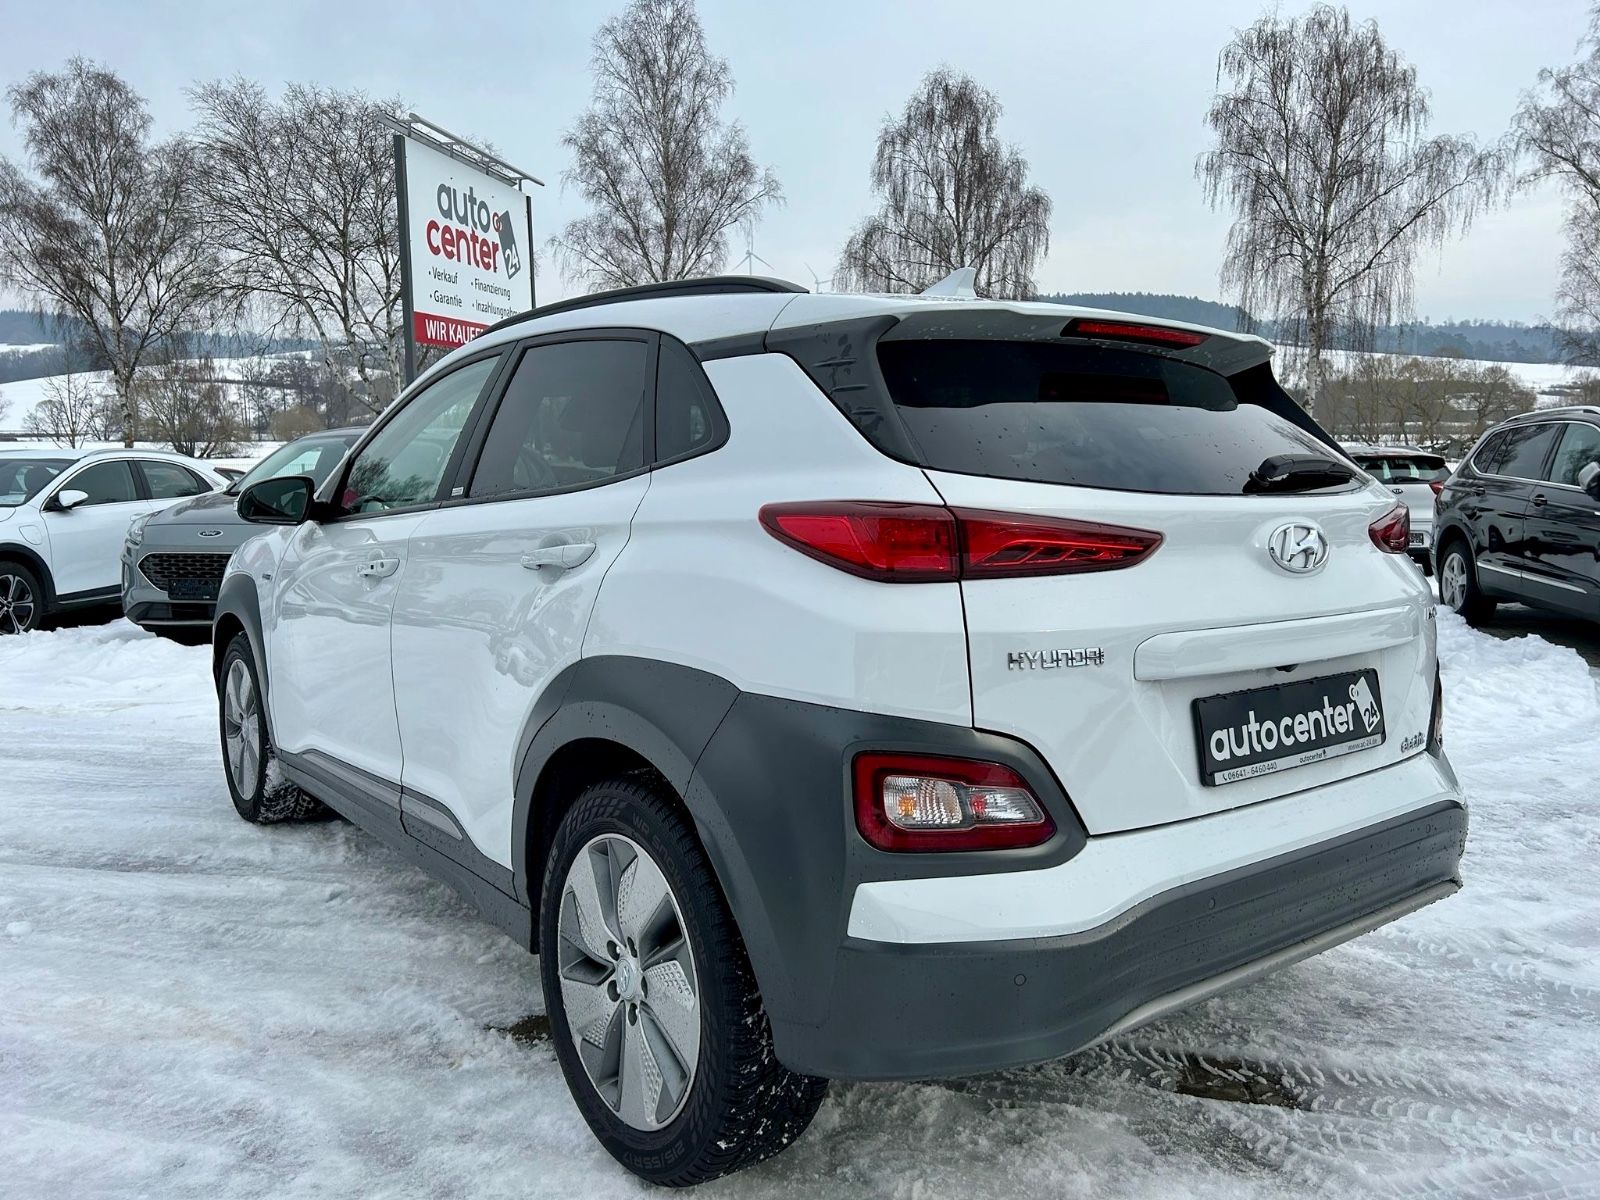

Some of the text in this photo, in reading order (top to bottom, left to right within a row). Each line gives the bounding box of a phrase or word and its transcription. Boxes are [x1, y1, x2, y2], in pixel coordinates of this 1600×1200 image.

[437, 183, 491, 233] auto
[426, 217, 499, 273] center
[504, 244, 521, 274] 24
[432, 267, 458, 285] Verkauf
[433, 290, 463, 308] Garantie
[474, 278, 511, 301] Finanzierung
[475, 299, 521, 319] Inzahlungnahm
[425, 319, 446, 342] WIR
[1007, 647, 1105, 671] HYUNDAI
[1363, 700, 1378, 728] 24
[1210, 695, 1355, 761] autocenter
